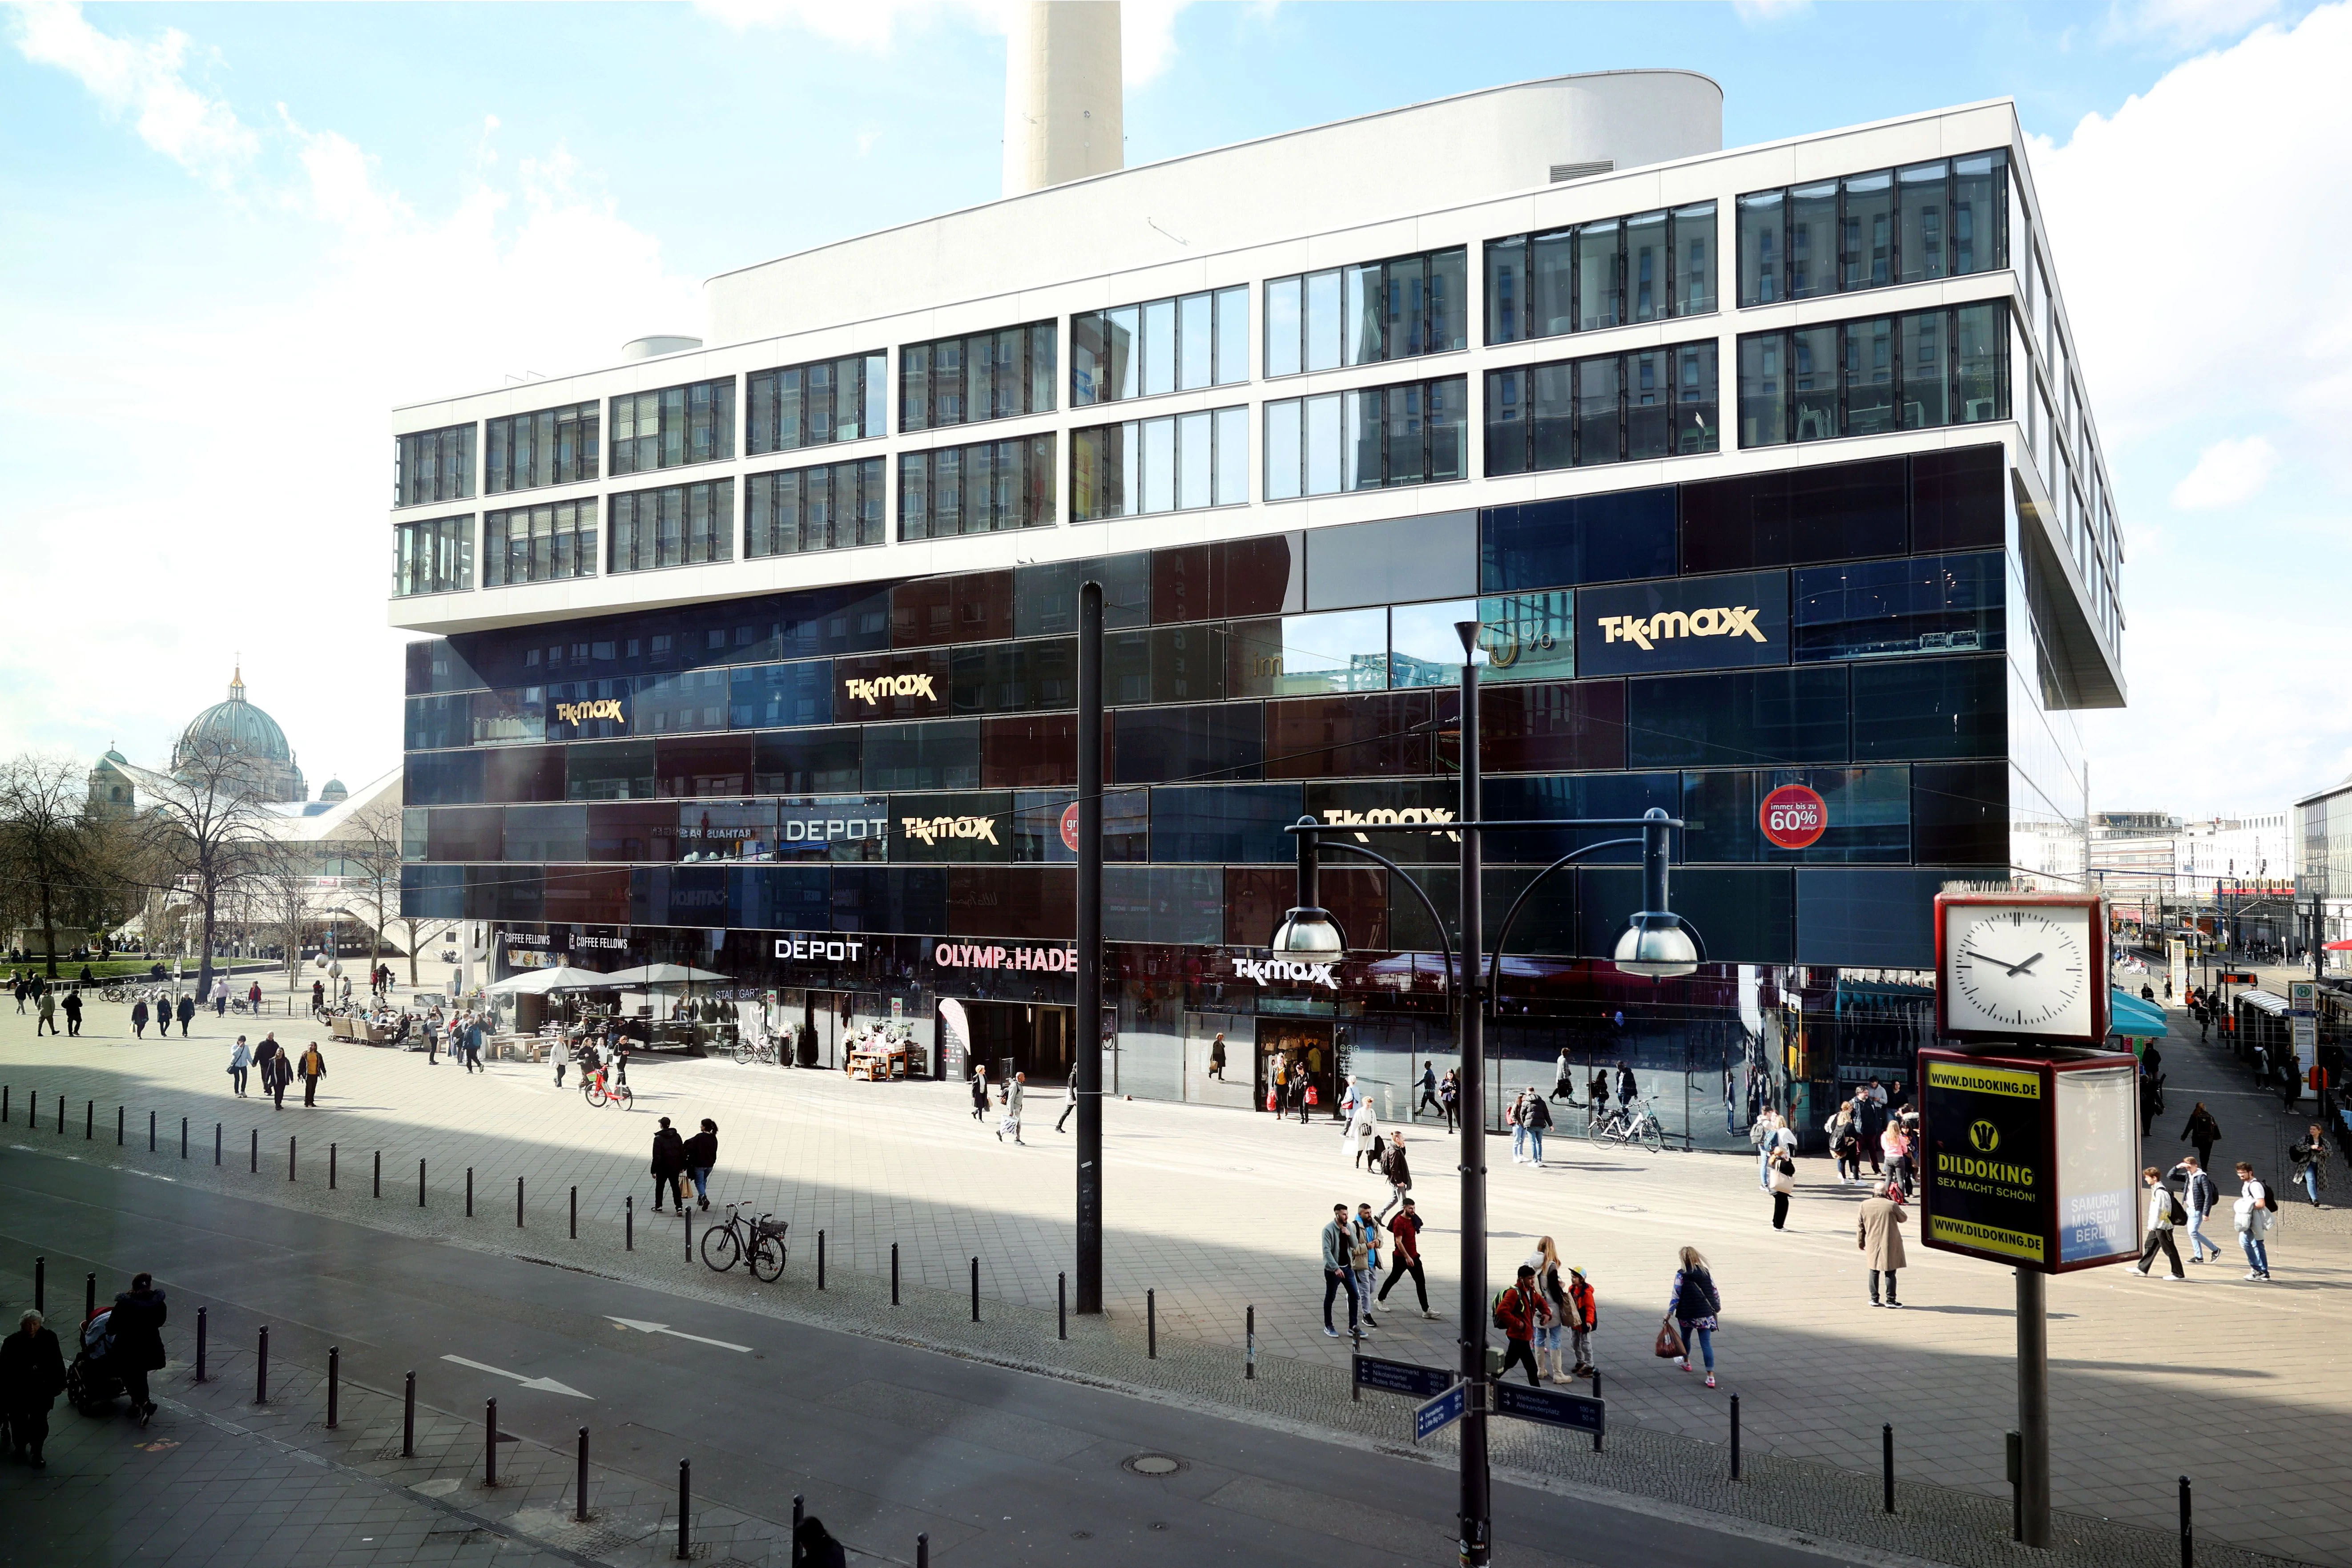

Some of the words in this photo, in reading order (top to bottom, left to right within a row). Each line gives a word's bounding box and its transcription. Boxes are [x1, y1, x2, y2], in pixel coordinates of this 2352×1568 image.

[786, 818, 888, 841] DEPOT
[1770, 810, 1817, 830] 60%
[505, 933, 524, 943] COFFEE
[525, 934, 550, 945] FELLOWS
[576, 936, 598, 948] COFFEE
[600, 937, 628, 949] FELLOWS
[775, 939, 862, 961] DEPOT
[1931, 1072, 2037, 1095] WWW.DILDOKING.DE
[1938, 1153, 2034, 1186] DILDOKING
[1937, 1177, 1956, 1188] SEX
[1959, 1180, 1994, 1194] MACHT
[1996, 1187, 2035, 1202] SCHÖN!
[2071, 1193, 2119, 1212] SAMURAI
[2072, 1208, 2120, 1228] MUSEUM
[1934, 1218, 2041, 1250] WWW.DILDOKING.DE
[2076, 1224, 2116, 1243] BERLIN
[1372, 1362, 1419, 1376] Gendarmenmarkt
[1373, 1370, 1407, 1381] Nikolaiviertel
[1372, 1377, 1388, 1385] Rotes
[1389, 1380, 1413, 1390] Rathaus
[1516, 1393, 1549, 1405] Weltzeituhr
[1516, 1402, 1560, 1415] Alexanderplatz
[1425, 1405, 1444, 1419] Fernsehturm
